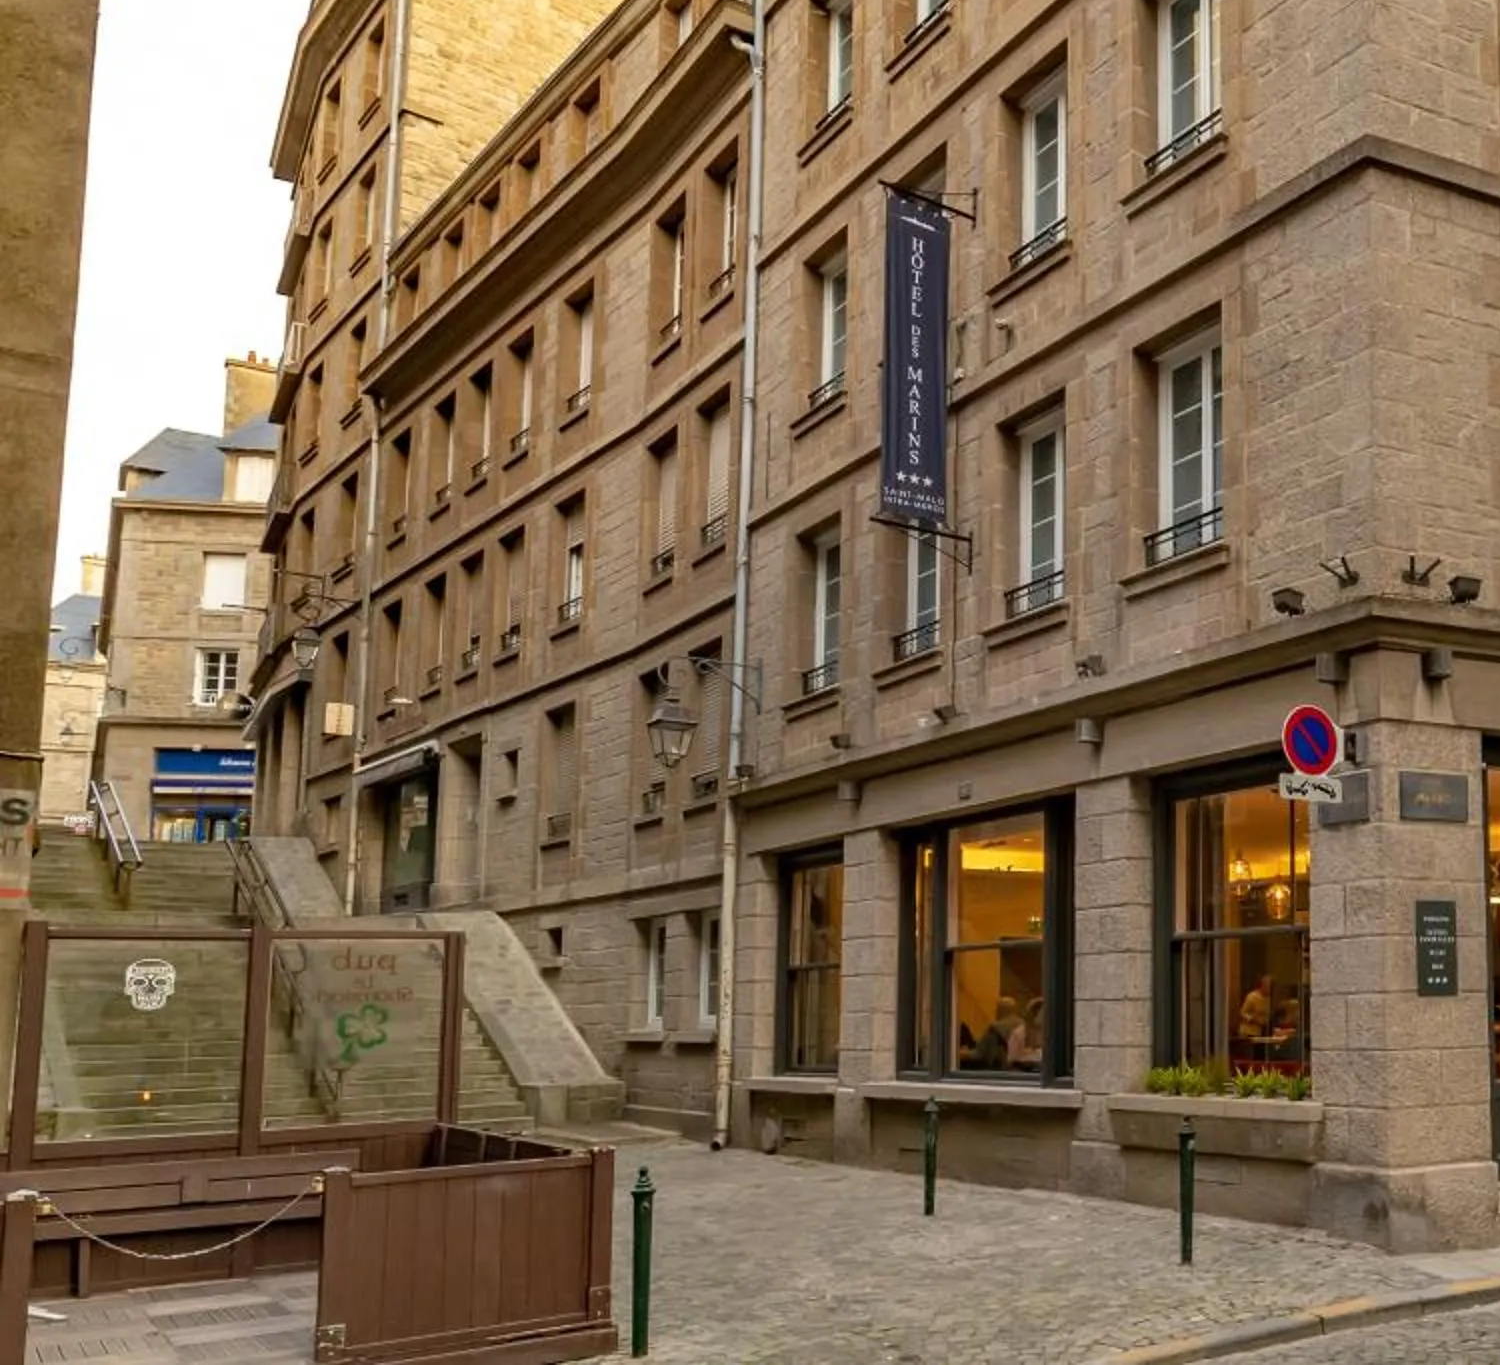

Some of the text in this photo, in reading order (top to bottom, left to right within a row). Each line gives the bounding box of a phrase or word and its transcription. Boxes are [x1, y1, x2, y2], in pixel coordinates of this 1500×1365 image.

[906, 236, 926, 465] HÔTEL DES MARINS
